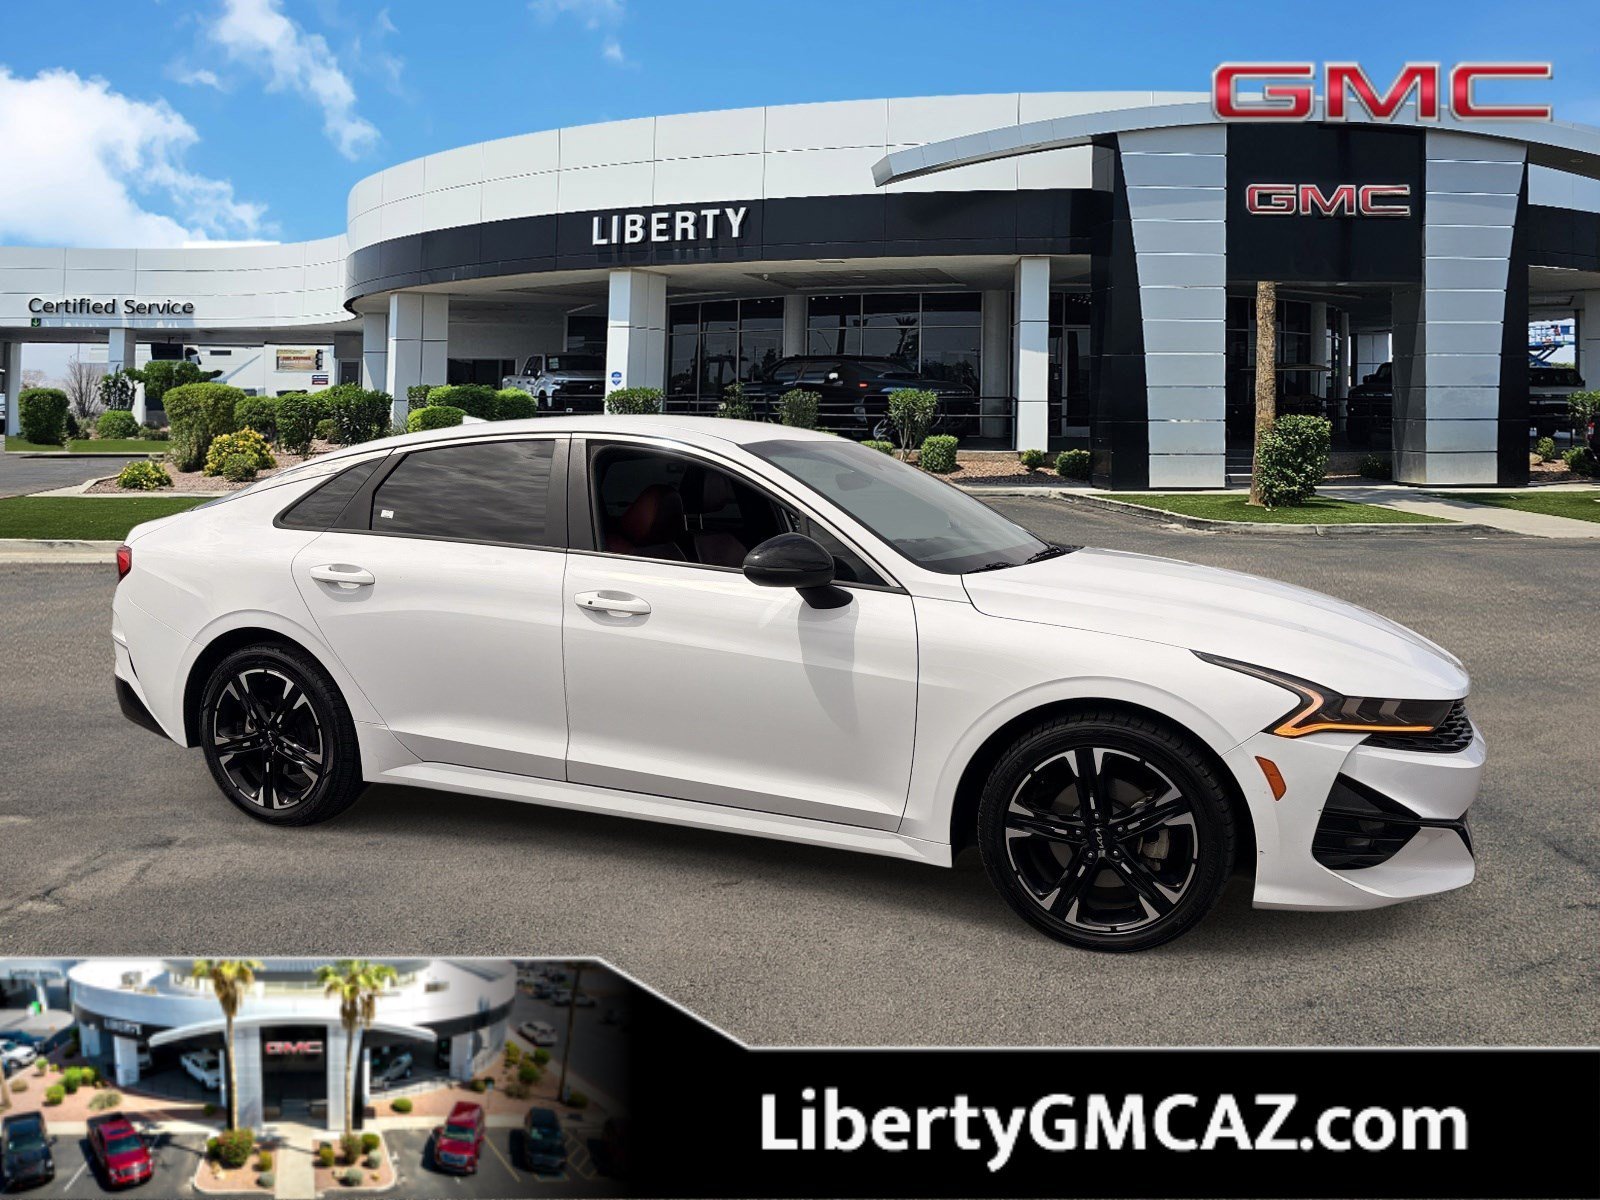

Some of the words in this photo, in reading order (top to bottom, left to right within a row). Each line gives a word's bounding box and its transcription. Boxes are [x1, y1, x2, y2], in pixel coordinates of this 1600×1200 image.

[1246, 184, 1411, 216] GMC
[592, 207, 747, 245] LIBERTY
[28, 298, 116, 314] Certified
[124, 299, 194, 314] Service
